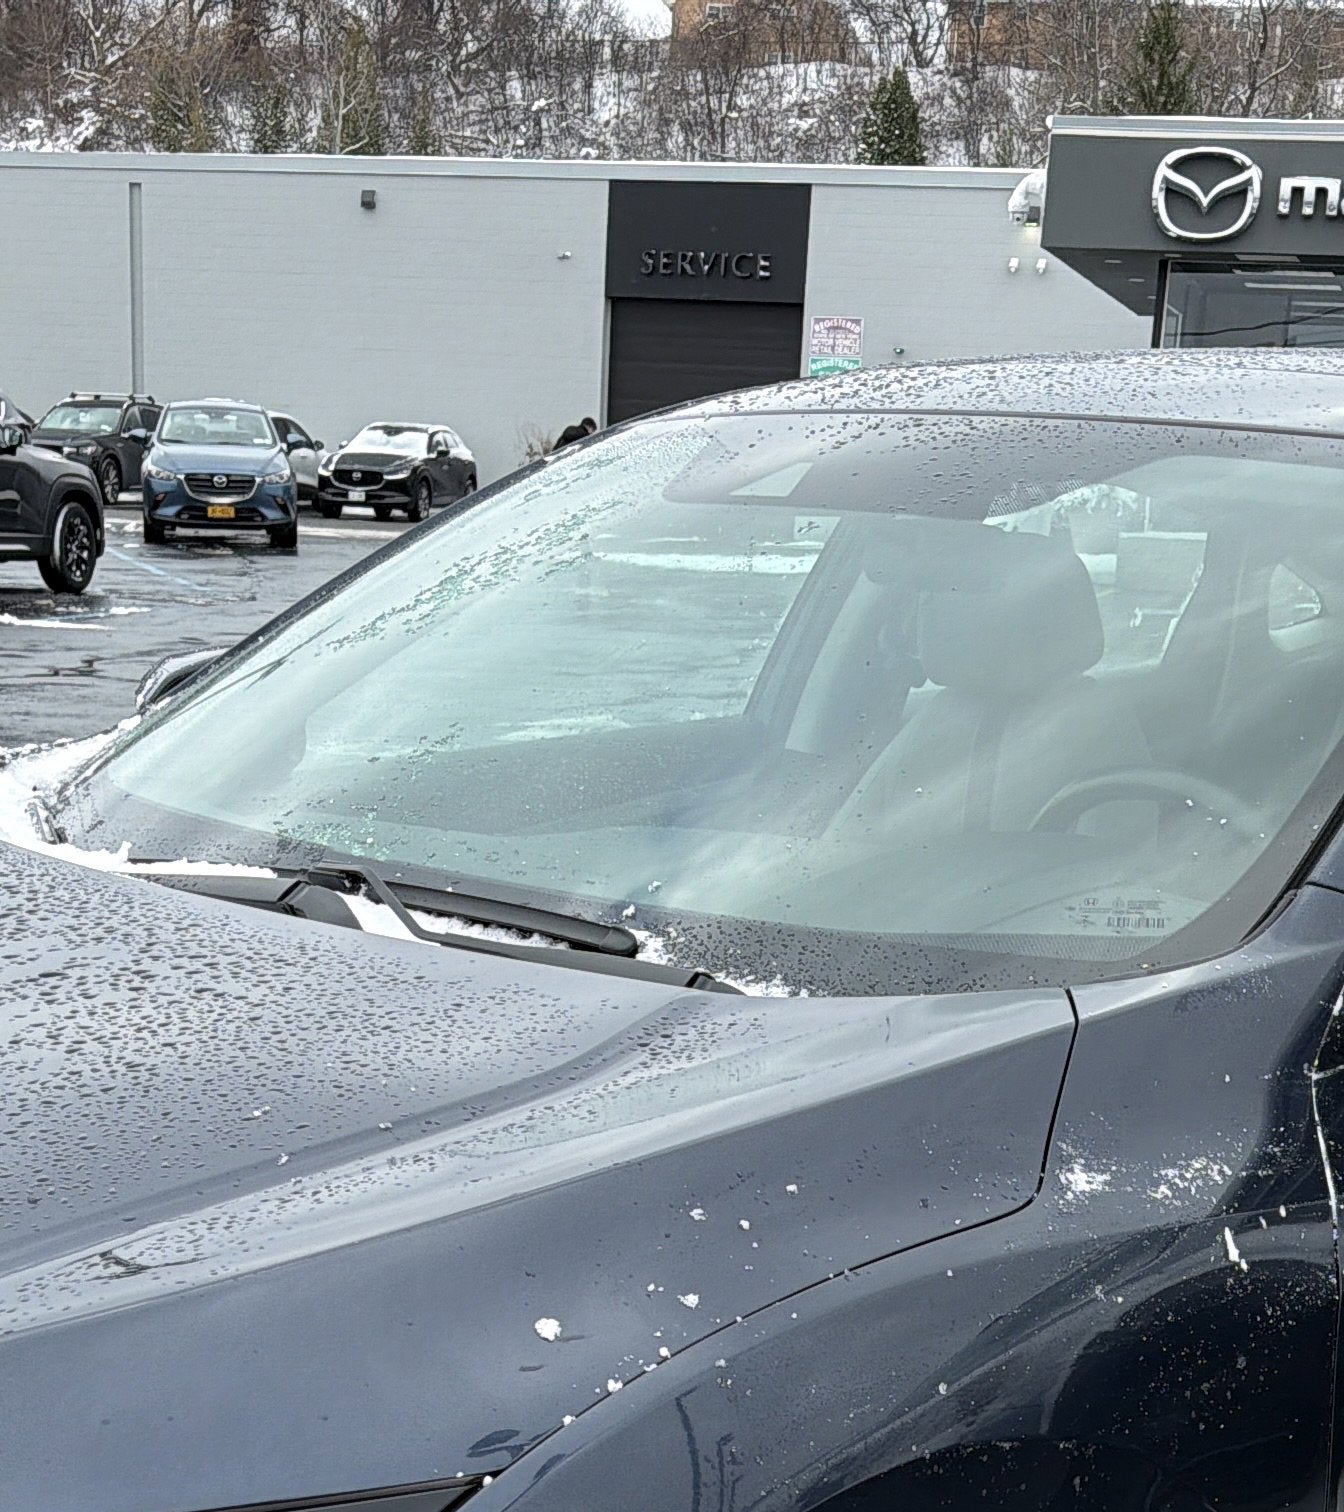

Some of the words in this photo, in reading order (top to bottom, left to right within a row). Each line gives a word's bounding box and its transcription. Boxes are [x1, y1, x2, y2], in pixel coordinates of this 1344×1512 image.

[640, 249, 773, 279] SERVICE
[814, 318, 860, 333] REGISTERED
[834, 346, 860, 355] DEALER
